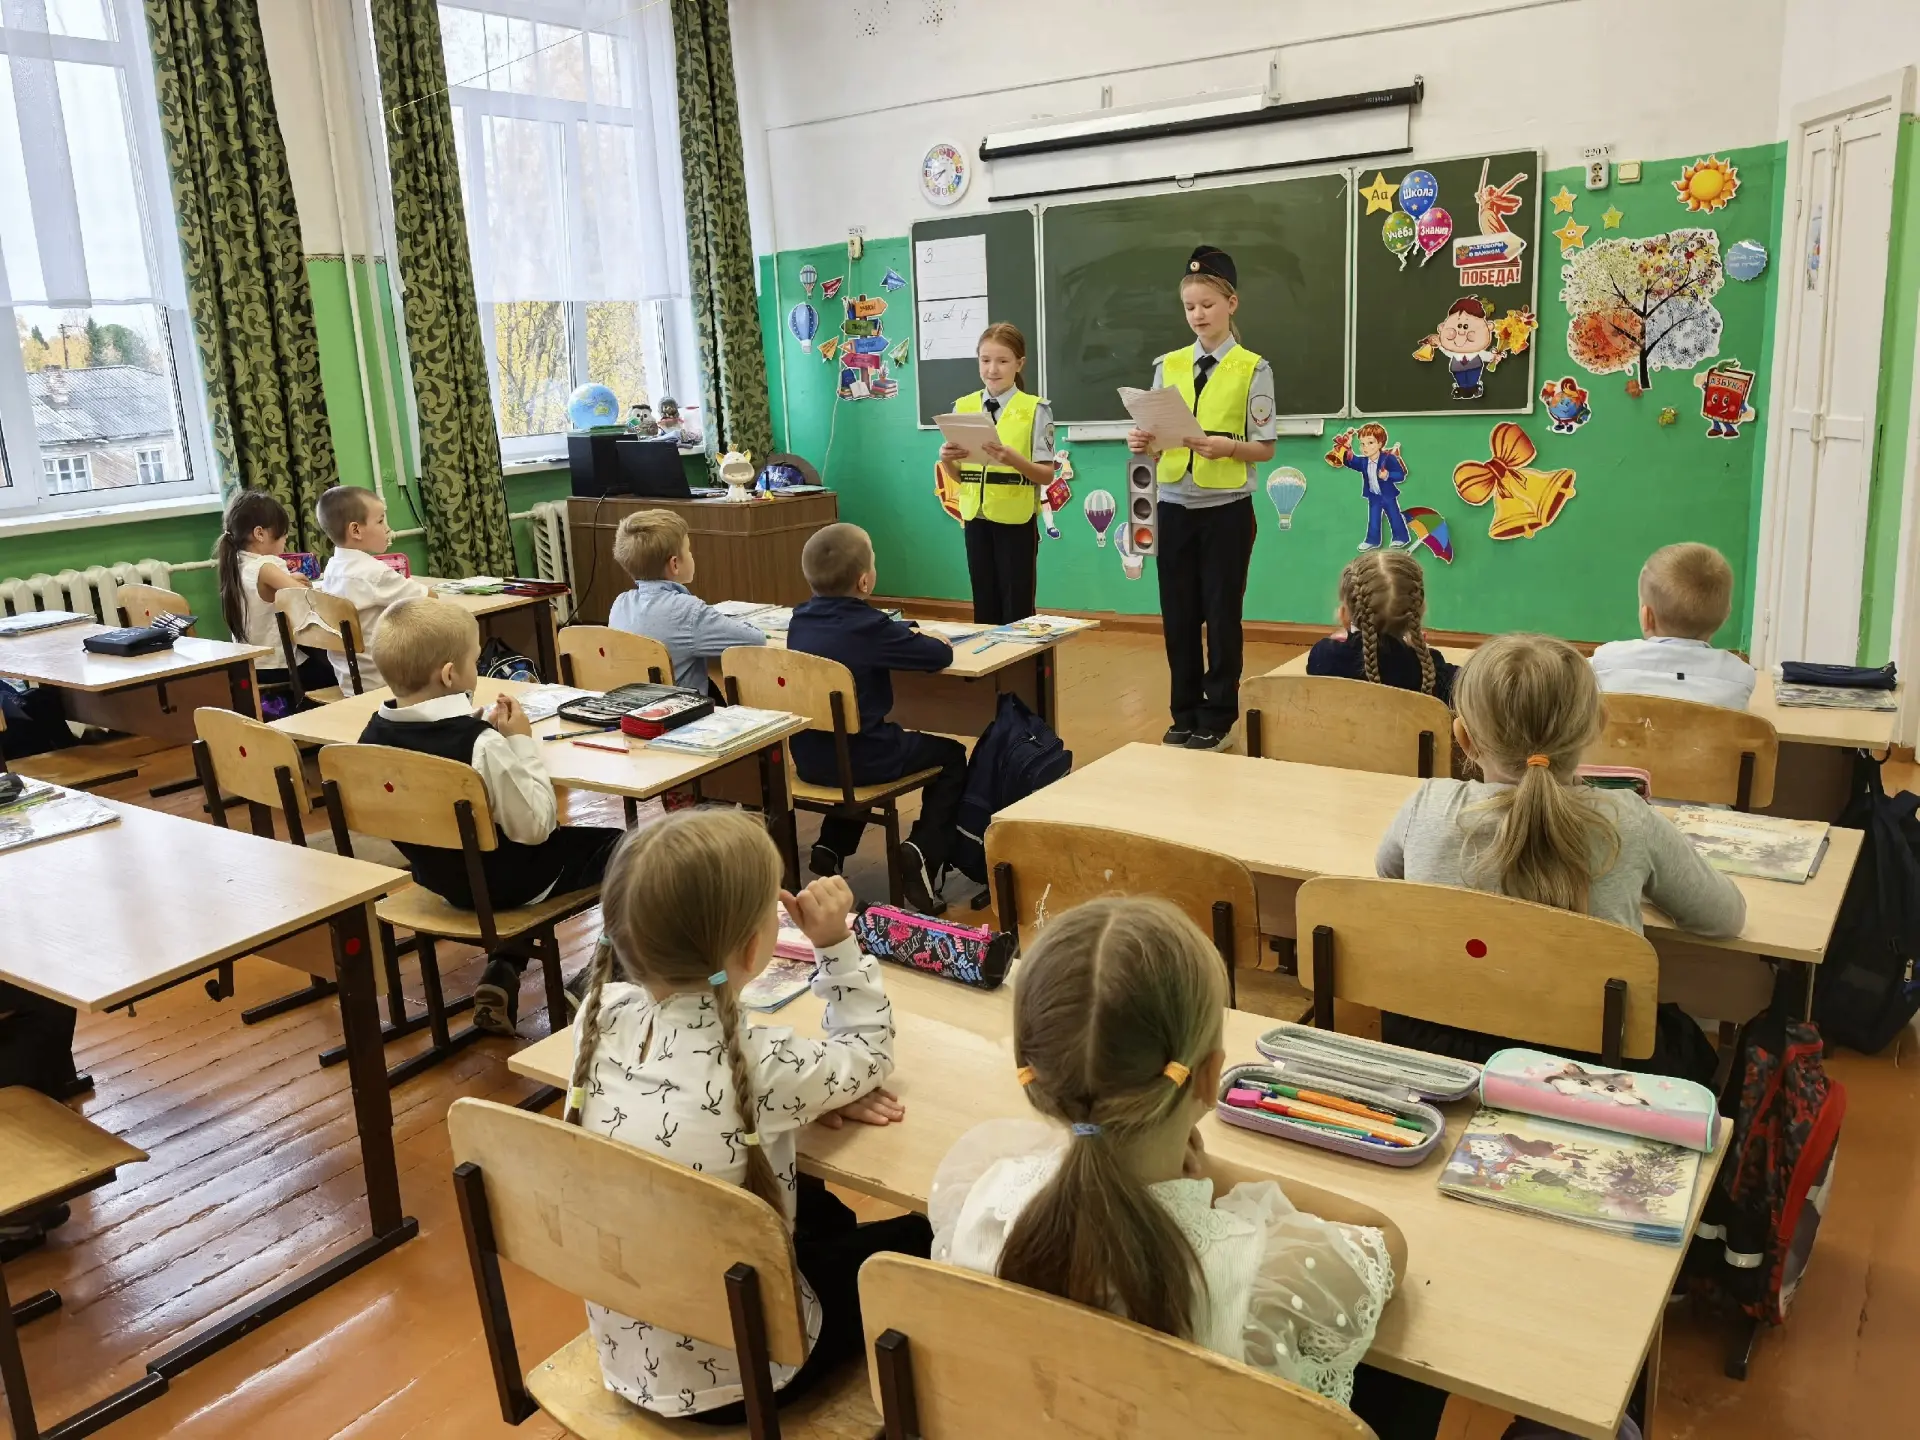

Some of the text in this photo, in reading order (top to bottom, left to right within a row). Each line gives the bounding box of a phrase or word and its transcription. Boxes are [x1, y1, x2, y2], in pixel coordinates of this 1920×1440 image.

[1371, 189, 1389, 201] Аа
[1403, 188, 1434, 200] Школа
[1461, 268, 1520, 285] ПОБЕДА!
[1710, 377, 1743, 391] АЗБУКА
